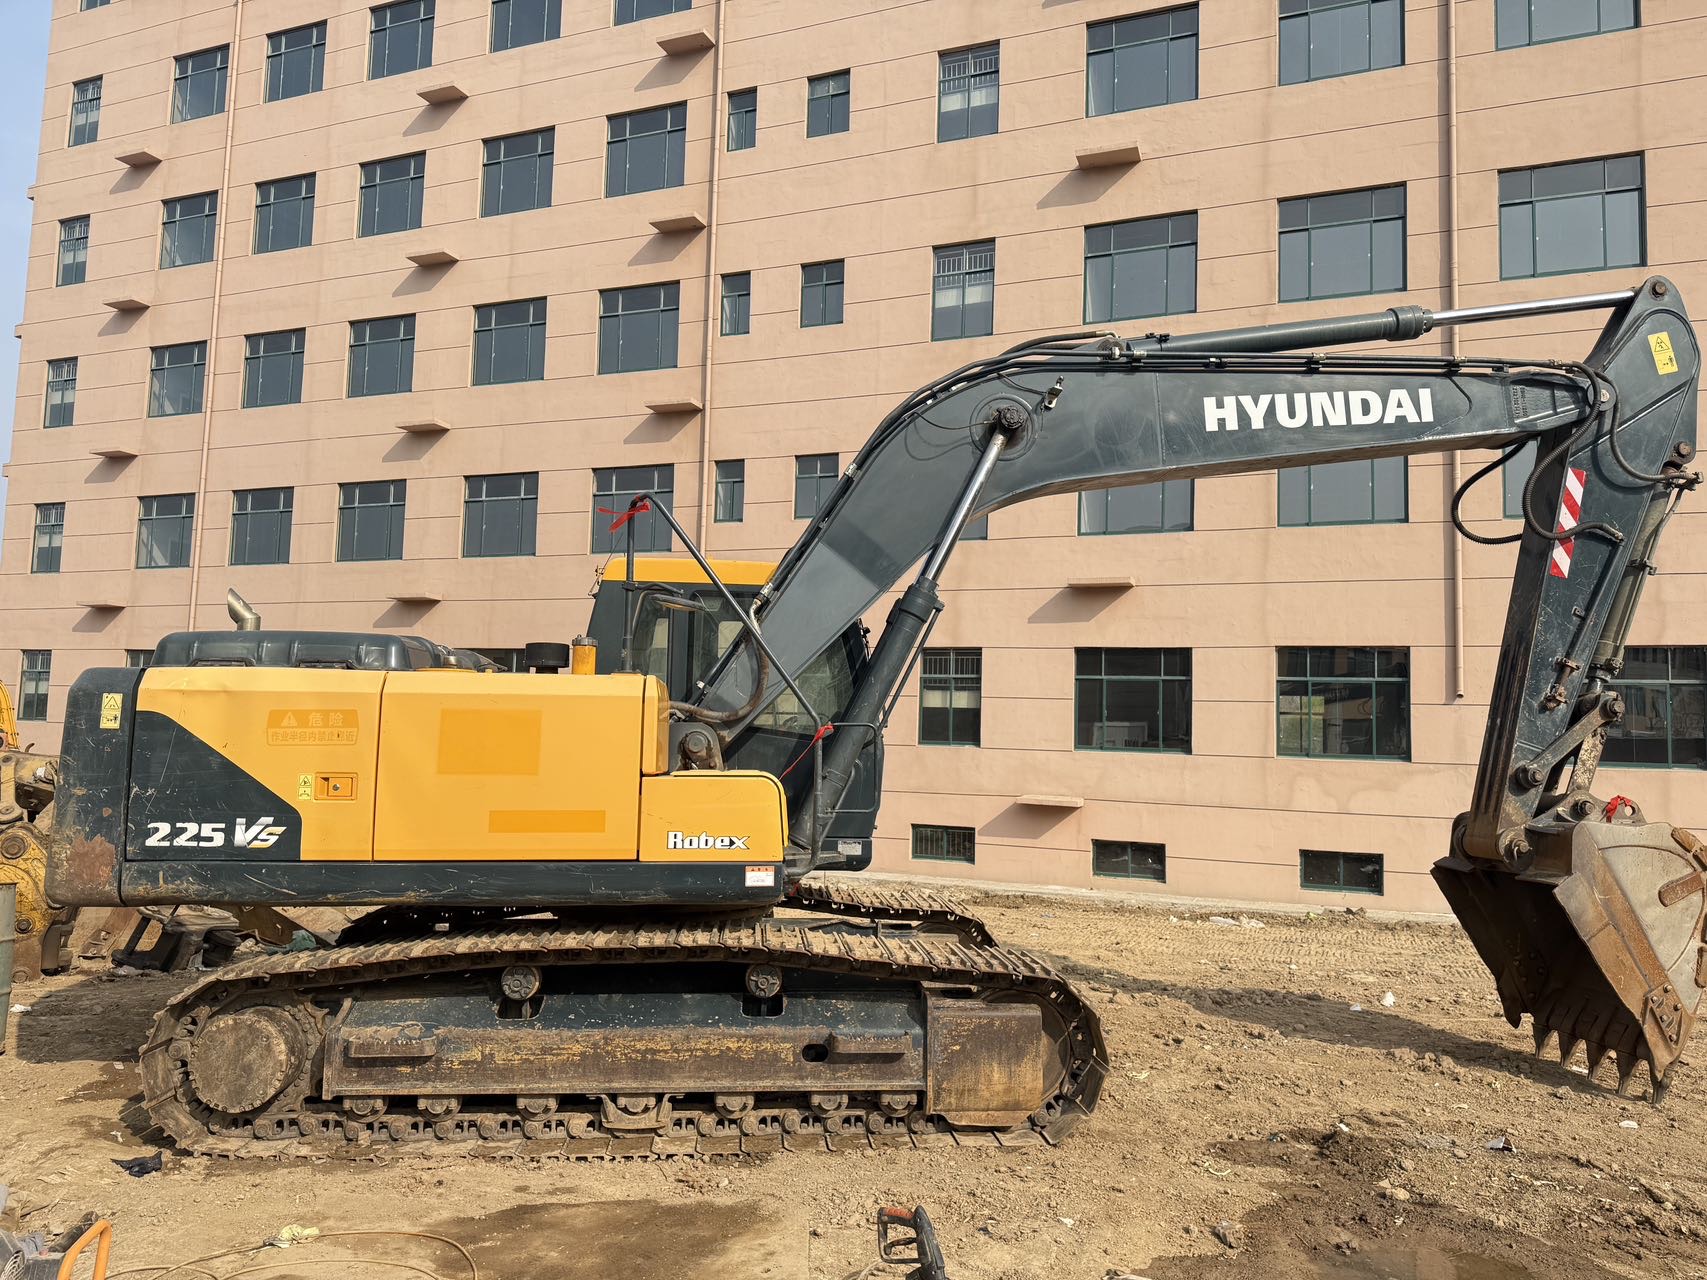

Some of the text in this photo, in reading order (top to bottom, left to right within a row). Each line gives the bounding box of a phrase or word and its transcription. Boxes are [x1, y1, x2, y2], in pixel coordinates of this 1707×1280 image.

[1203, 387, 1434, 432] HYUNDAI
[308, 711, 344, 727] 危险
[145, 822, 226, 847] 225
[667, 831, 750, 849] Robex
